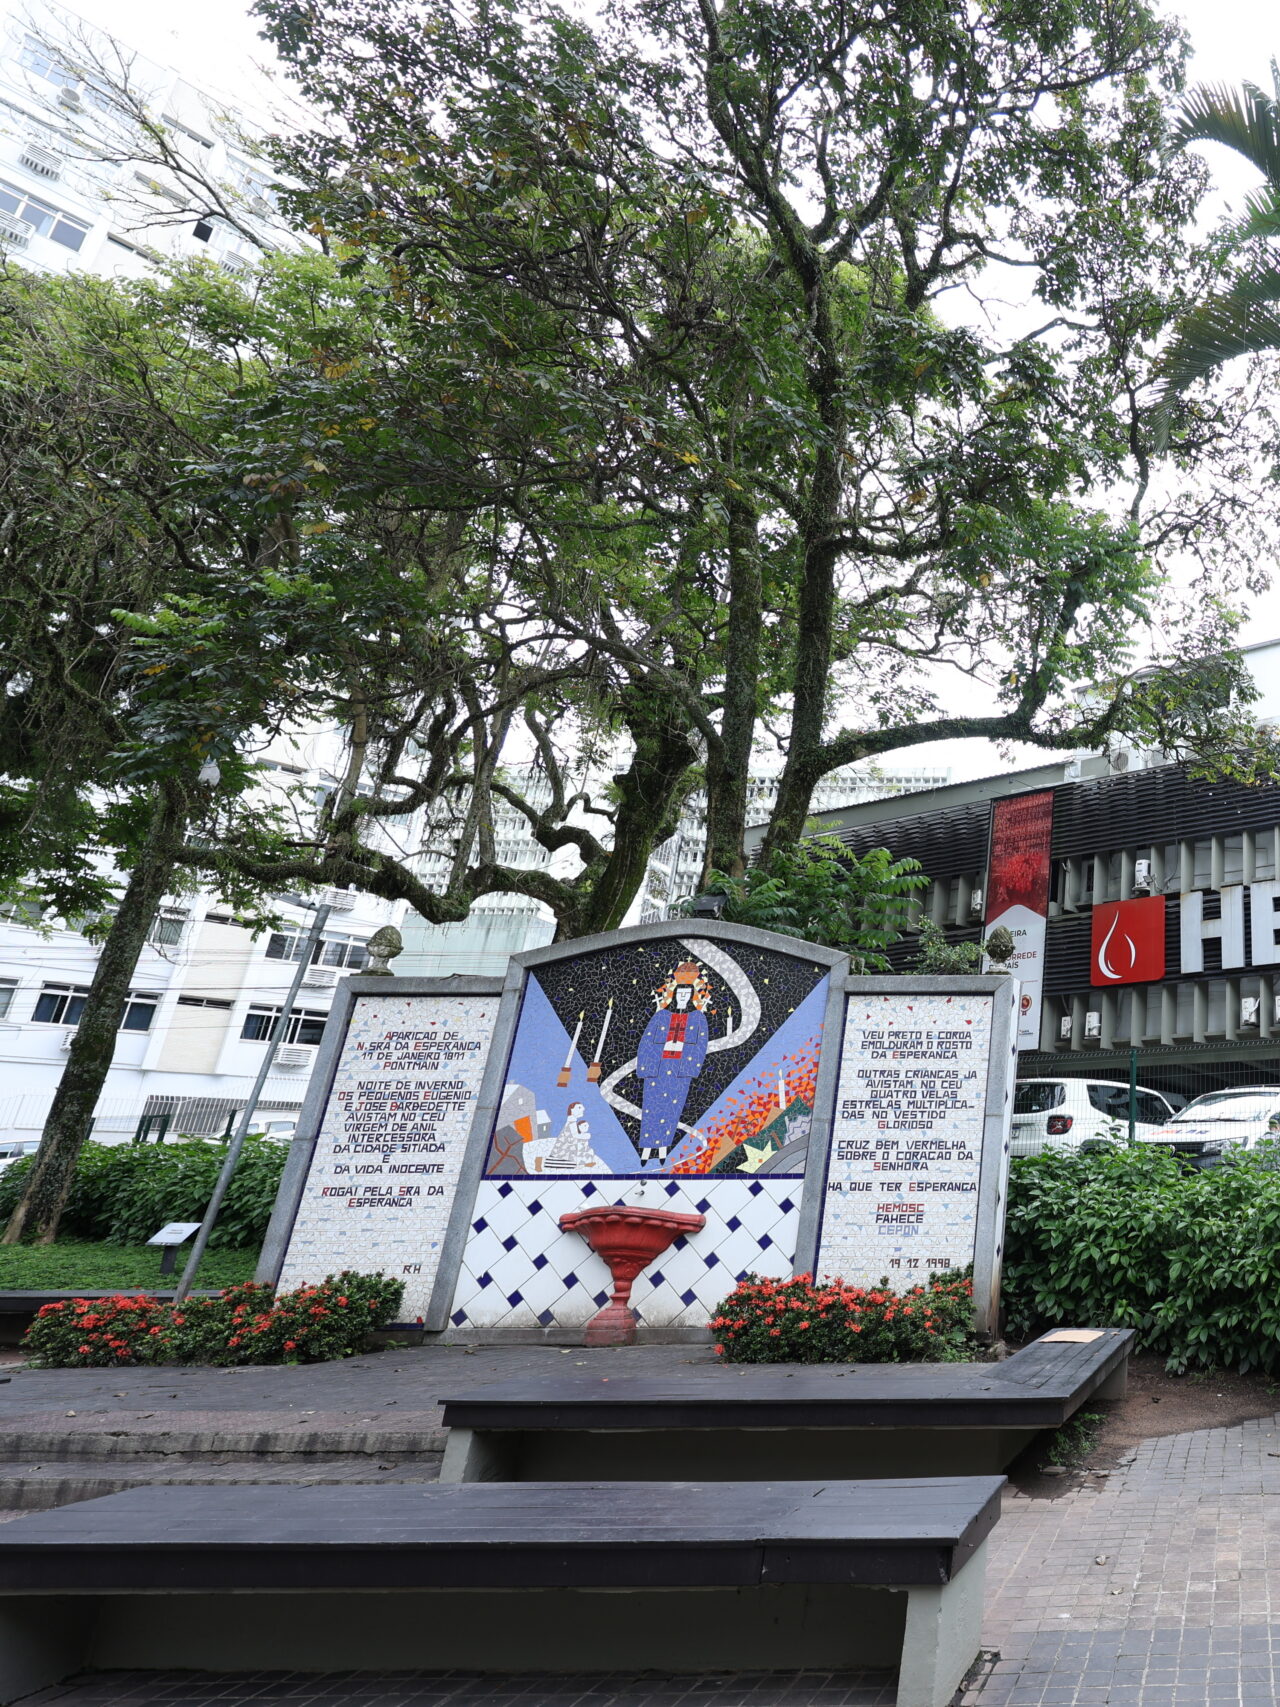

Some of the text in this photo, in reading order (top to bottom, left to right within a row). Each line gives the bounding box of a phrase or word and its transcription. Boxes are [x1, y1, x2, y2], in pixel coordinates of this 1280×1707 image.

[443, 1032, 459, 1040] DE
[863, 1031, 972, 1039] VEU PRETO E COROA
[395, 1042, 409, 1050] DA
[861, 1041, 972, 1049] EMOLDURAM O ROSTO
[871, 1051, 886, 1059] DA
[383, 1062, 439, 1070] PONTMAIN
[857, 1070, 900, 1078] OUTRAS
[964, 1071, 977, 1079] JA
[357, 1081, 464, 1089] NOITE DE INVERNO
[866, 1080, 913, 1088] AVISTAM
[941, 1080, 962, 1089] CEU
[338, 1091, 471, 1100] OS PEQUENOS EUGENIO
[870, 1090, 957, 1099] QUATRO VELAS
[344, 1102, 465, 1111] E JOSE BARBEDETTE
[843, 1101, 901, 1109] ESTRELAS
[346, 1113, 445, 1121] AVISTAM NO CEU
[842, 1111, 946, 1119] DAS NO VESTIDO
[345, 1123, 437, 1132] VIRGEM DE ANIL
[878, 1121, 933, 1129] GLORIOSO
[348, 1133, 436, 1142] INTERCESSORA
[333, 1143, 445, 1153] DA CIDADE SITIADA
[838, 1141, 966, 1150] CRUZ BEM VERMELHA
[382, 1155, 391, 1163] E
[837, 1152, 876, 1160] SOBRE
[882, 1152, 889, 1160] O
[958, 1152, 973, 1160] DA
[334, 1164, 444, 1174] DA VIDA INOCENTE
[873, 1162, 928, 1171] SENHORA
[828, 1182, 842, 1191] HA
[850, 1182, 872, 1191] QUE
[880, 1182, 901, 1191] TER
[322, 1186, 444, 1196] ROGAI PELA SRA DA
[877, 1204, 925, 1212] HEMOSC
[876, 1215, 923, 1223] FAHECE
[878, 1225, 919, 1235] CEPON
[889, 1259, 900, 1268] 19
[926, 1259, 950, 1268] 1998
